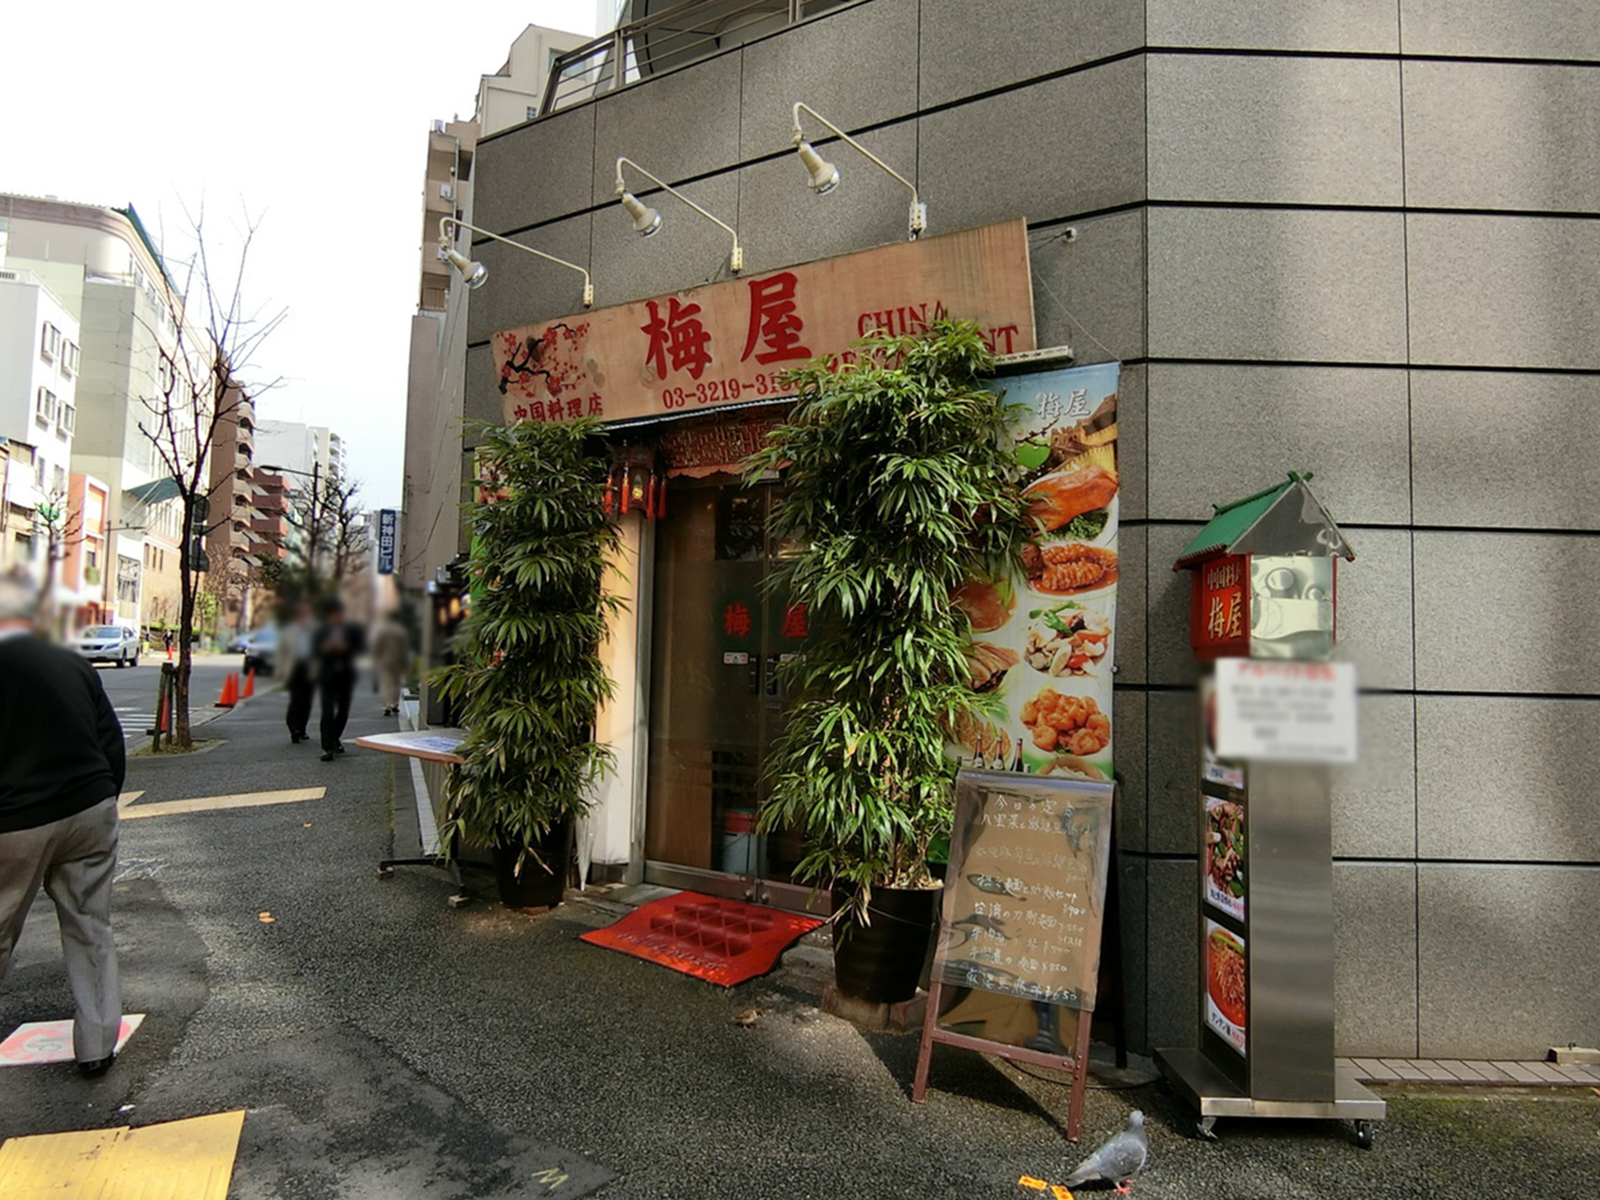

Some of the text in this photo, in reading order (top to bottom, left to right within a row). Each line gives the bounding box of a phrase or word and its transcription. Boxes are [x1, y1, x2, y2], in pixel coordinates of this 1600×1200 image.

[640, 271, 813, 381] 梅屋
[512, 392, 604, 421] 中国料理店
[661, 367, 801, 410] 03-3219-31
[1036, 388, 1091, 419] 梅屋
[380, 513, 395, 570] 新神田ビル
[1208, 591, 1242, 639] 梅屋
